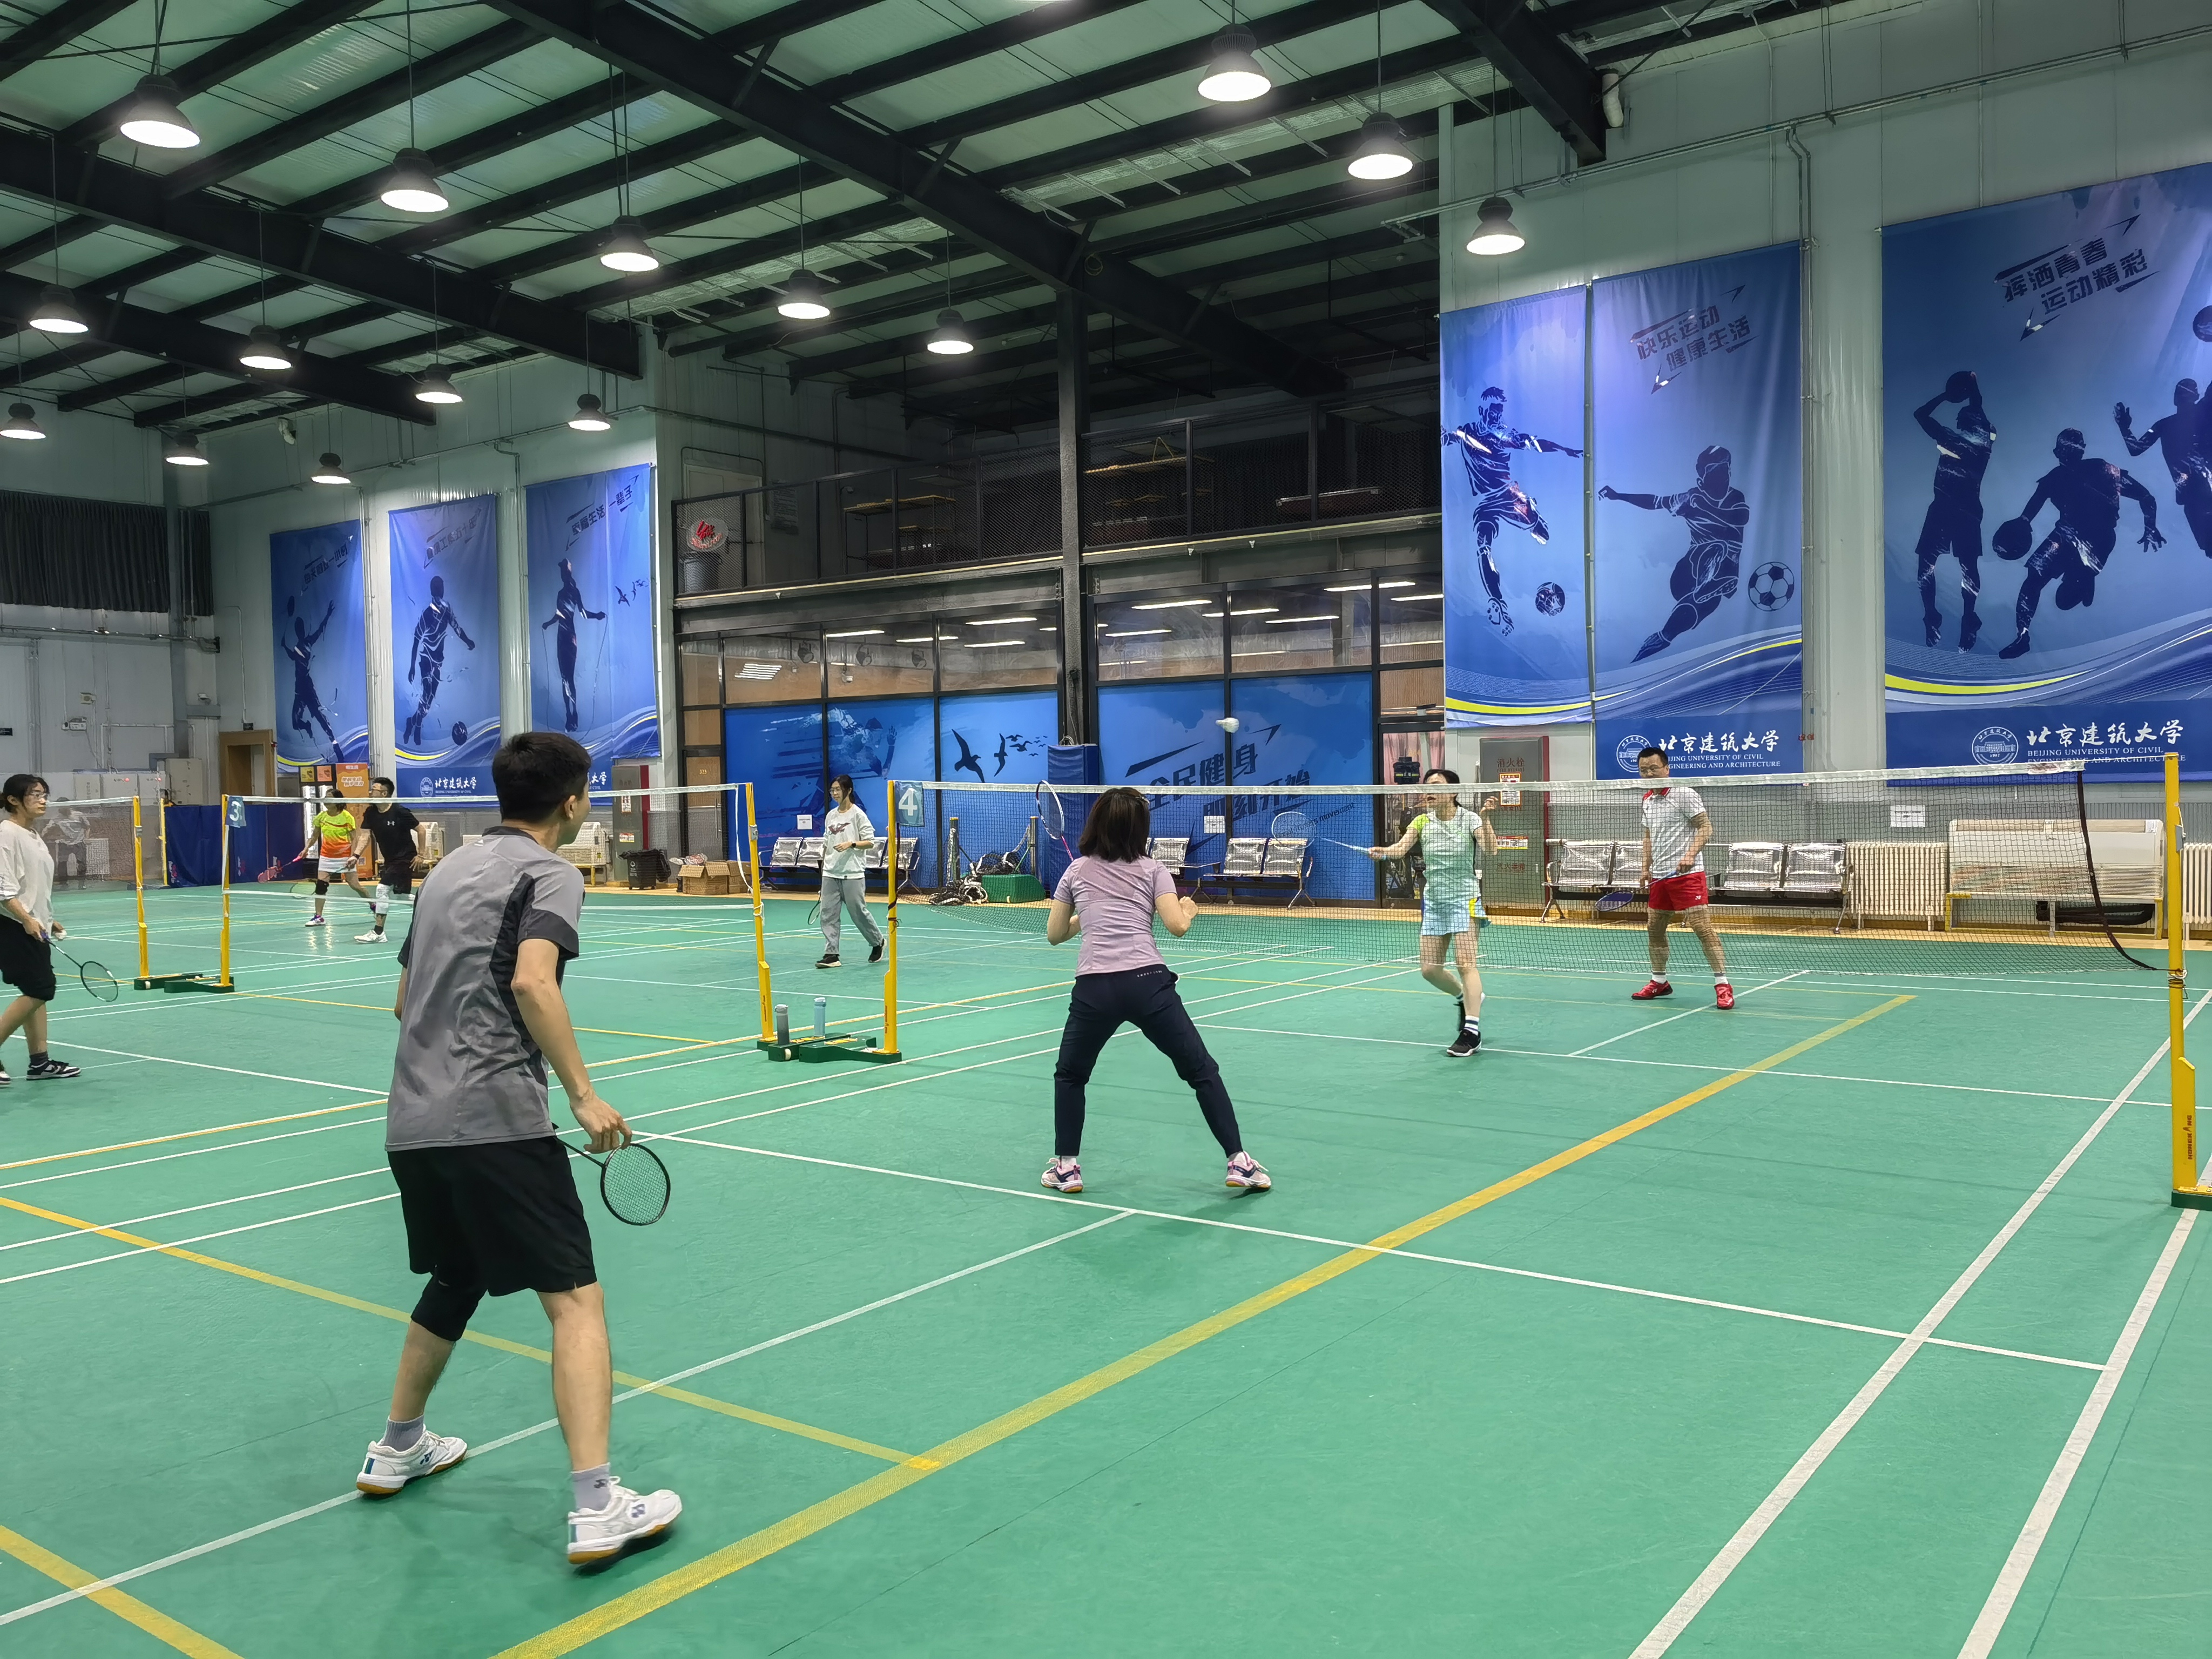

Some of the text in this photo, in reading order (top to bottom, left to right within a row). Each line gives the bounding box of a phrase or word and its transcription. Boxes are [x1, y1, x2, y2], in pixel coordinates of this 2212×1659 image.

[2002, 238, 2107, 302] 挥洒青春
[2041, 248, 2148, 315] 运动精彩
[1636, 305, 1719, 360] 快乐运动
[1666, 315, 1750, 372] 健康生活
[1658, 730, 1779, 754] 北京建筑大学
[2026, 719, 2183, 747] 北京建筑大学
[1496, 757, 1525, 768] 消火栓
[2065, 747, 2120, 756] UNIVERSITY
[588, 771, 607, 785] 大学
[1148, 743, 1258, 811] 全民健身
[230, 801, 241, 821] 3
[898, 787, 918, 816] 4
